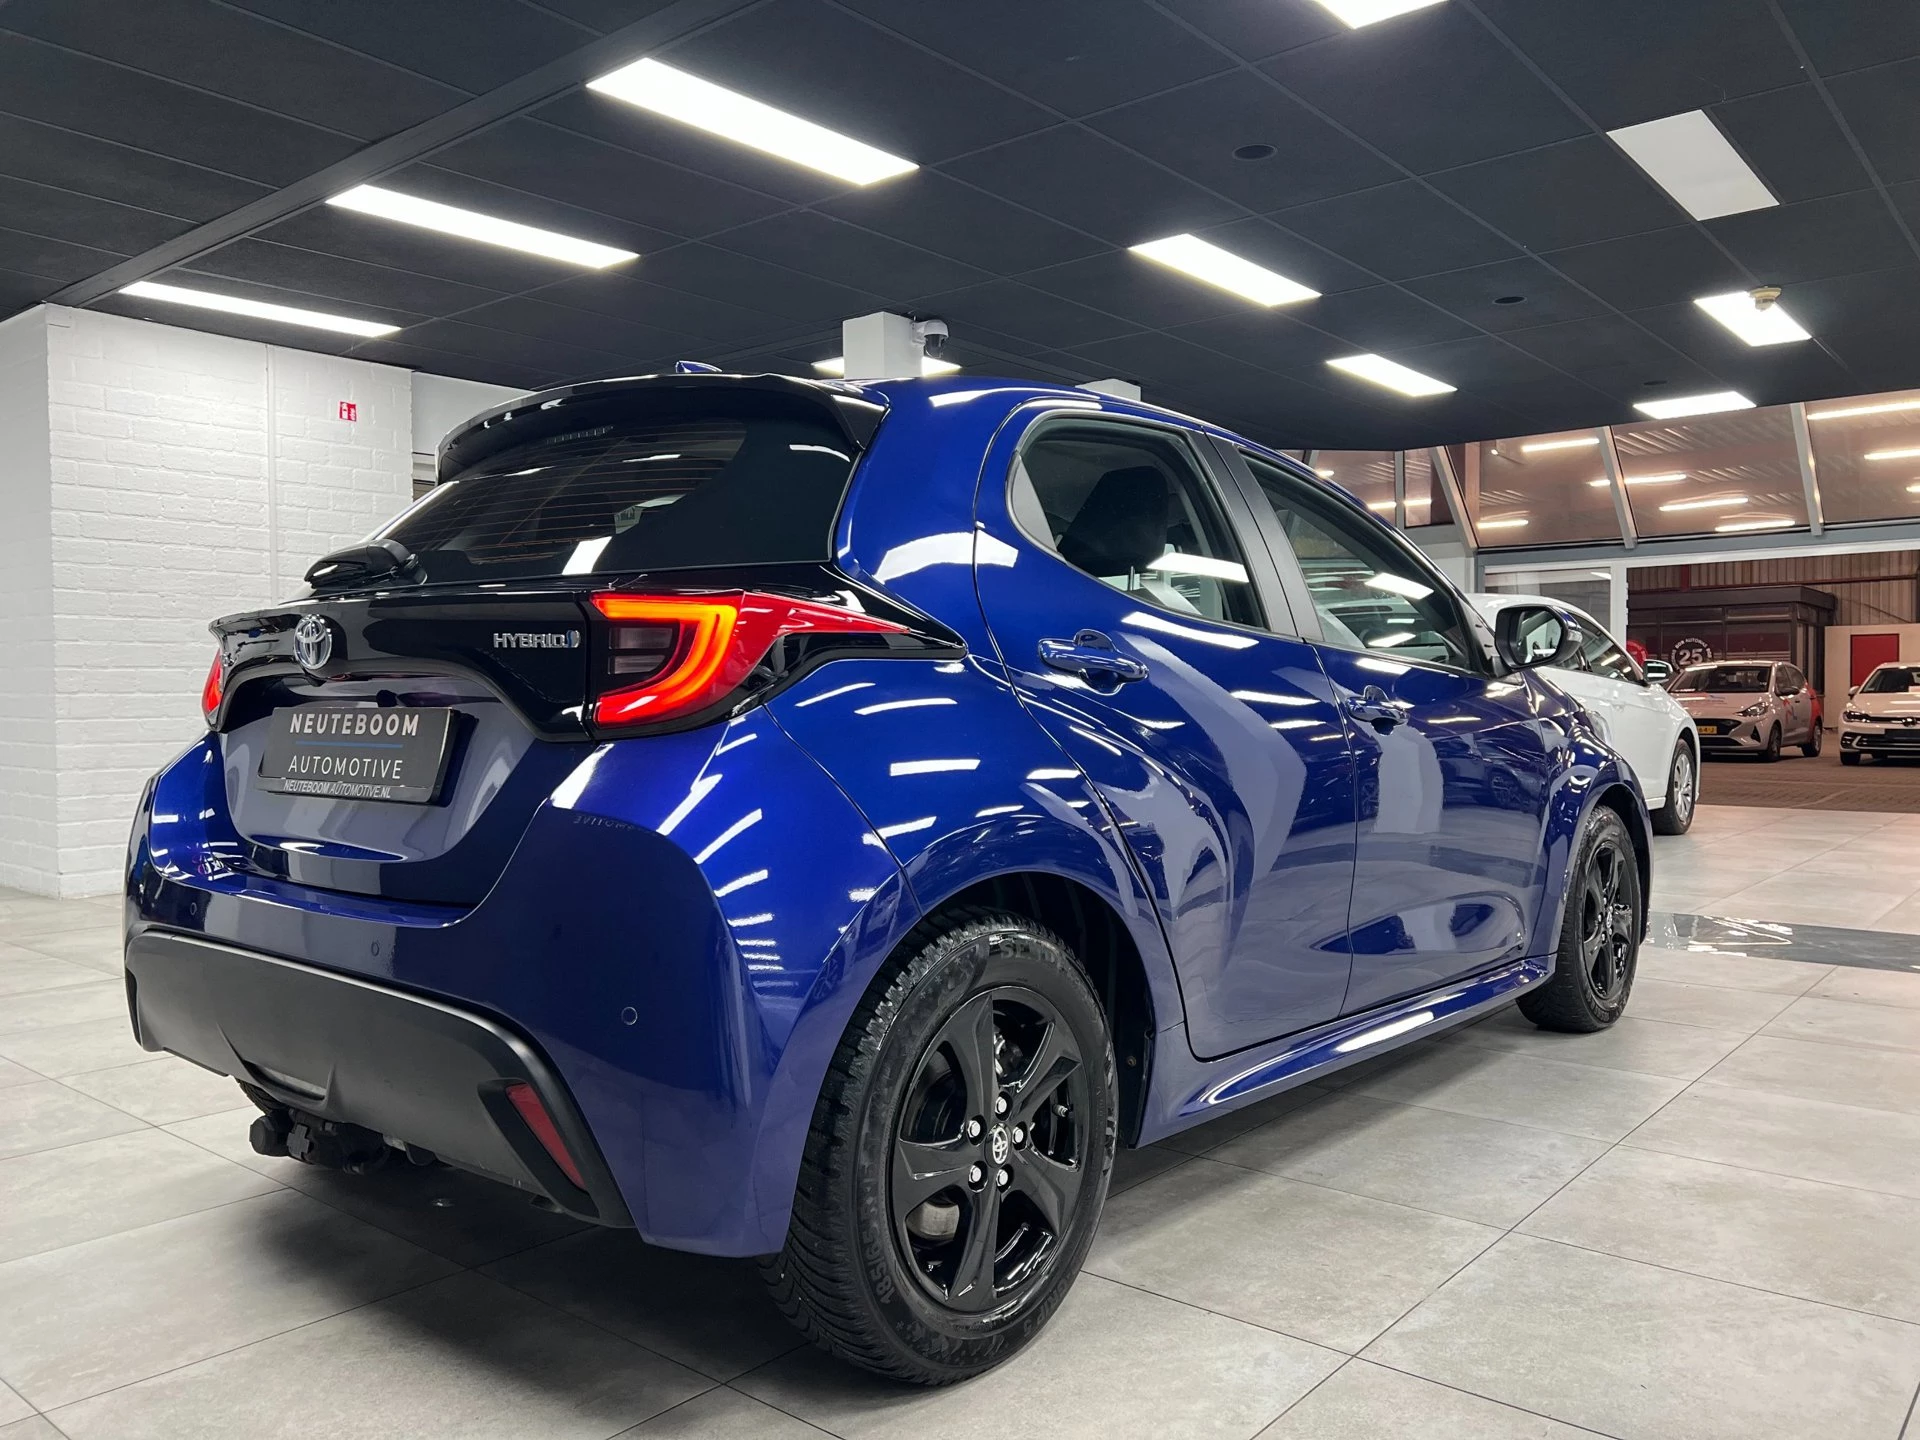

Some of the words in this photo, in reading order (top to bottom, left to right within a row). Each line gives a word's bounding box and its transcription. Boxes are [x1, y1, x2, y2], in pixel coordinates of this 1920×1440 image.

[493, 632, 566, 649] HYBRID
[1679, 648, 1703, 665] 25
[289, 713, 419, 736] NEUTEBOOM
[288, 755, 403, 779] AUTOMOTIVE
